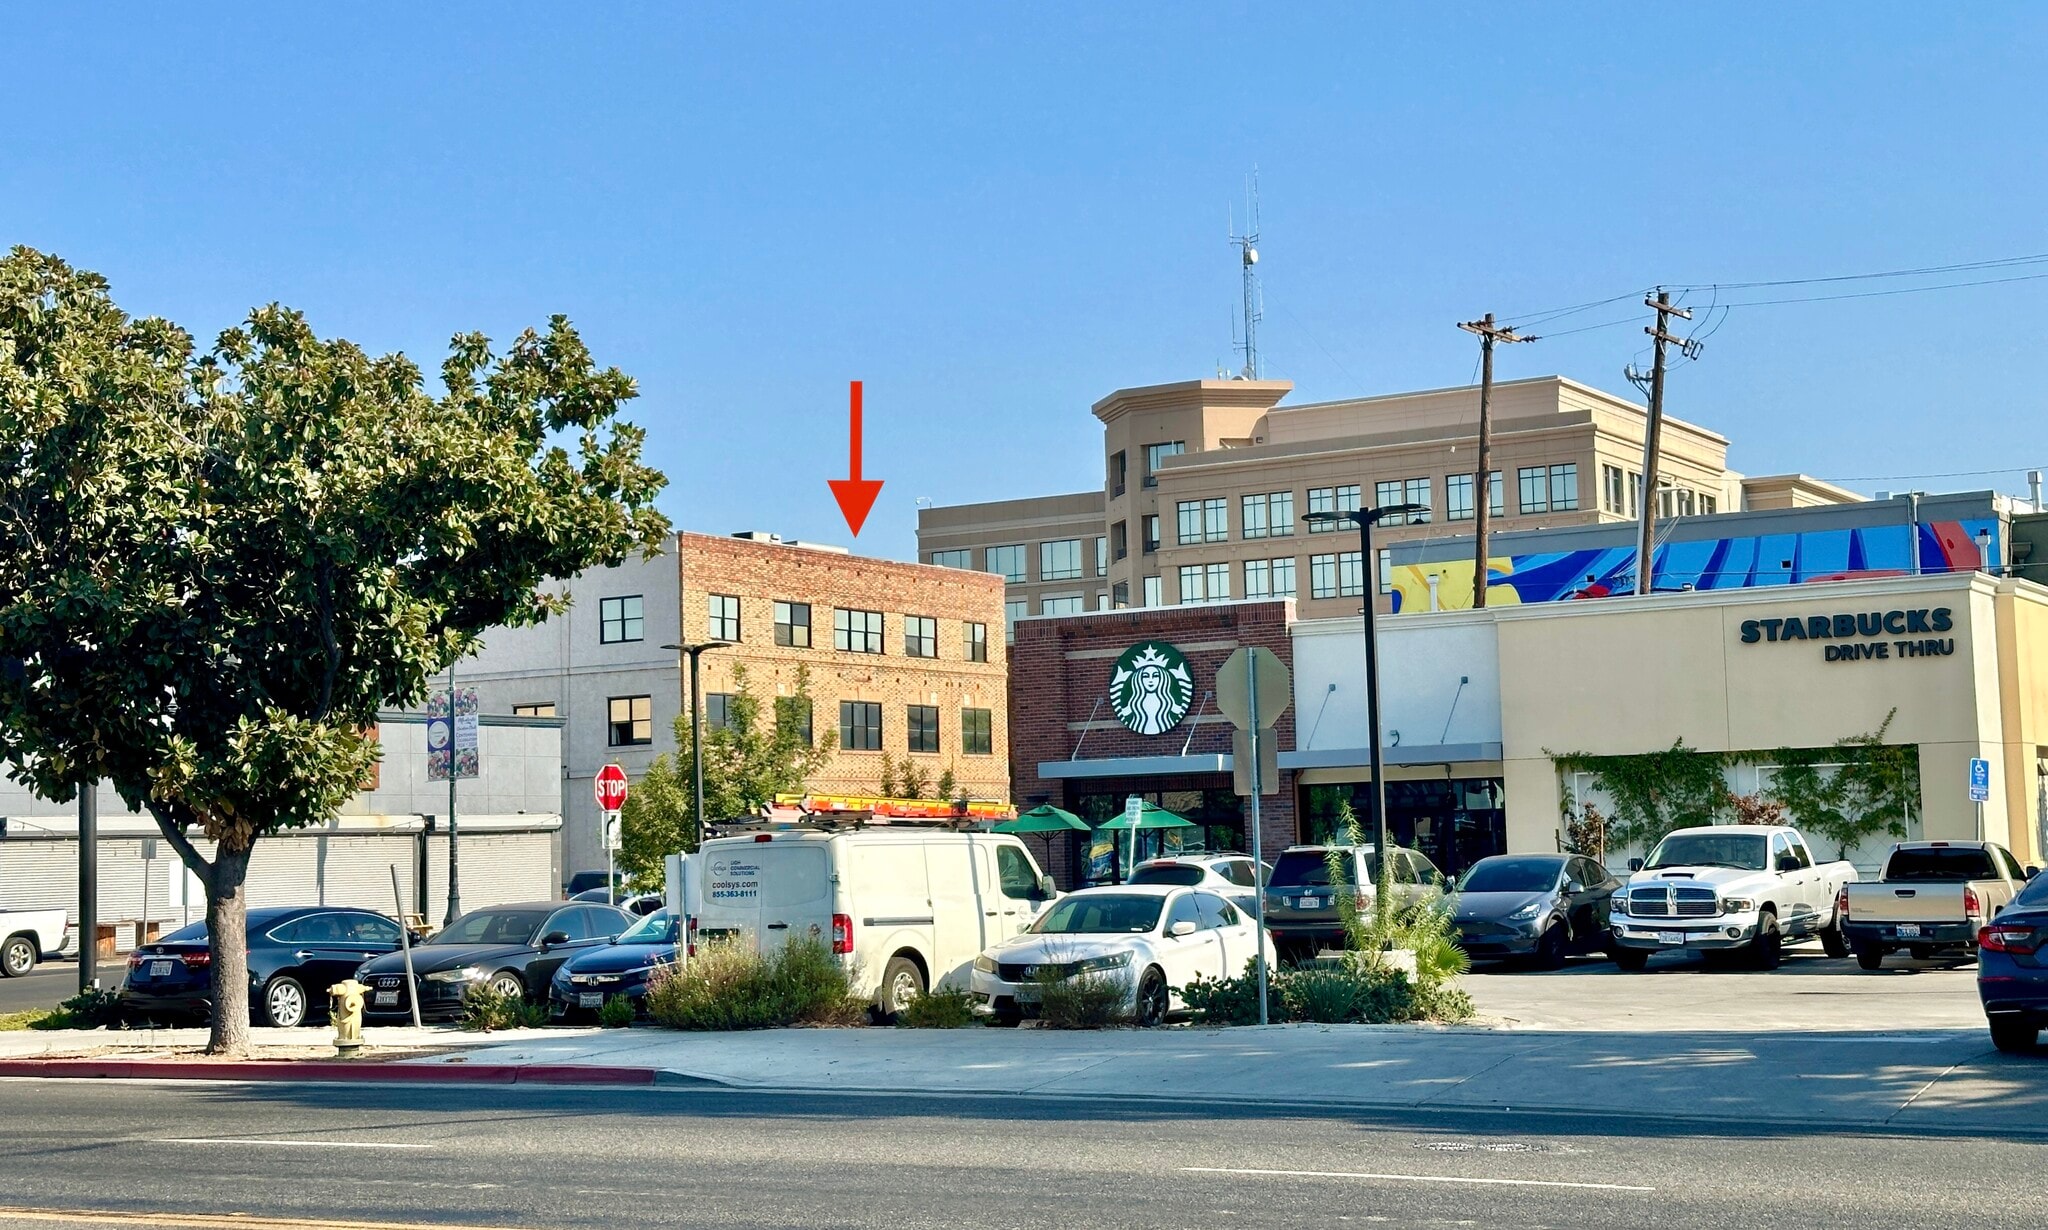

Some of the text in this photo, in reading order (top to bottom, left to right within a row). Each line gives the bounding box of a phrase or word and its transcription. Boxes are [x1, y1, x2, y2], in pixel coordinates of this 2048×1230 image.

[1740, 607, 1954, 643] STARBUCKS
[1824, 638, 1955, 662] DRIVE THRU
[598, 779, 625, 797] STOP
[712, 880, 759, 890] coolsys.com
[712, 890, 757, 898] 855-363-8111
